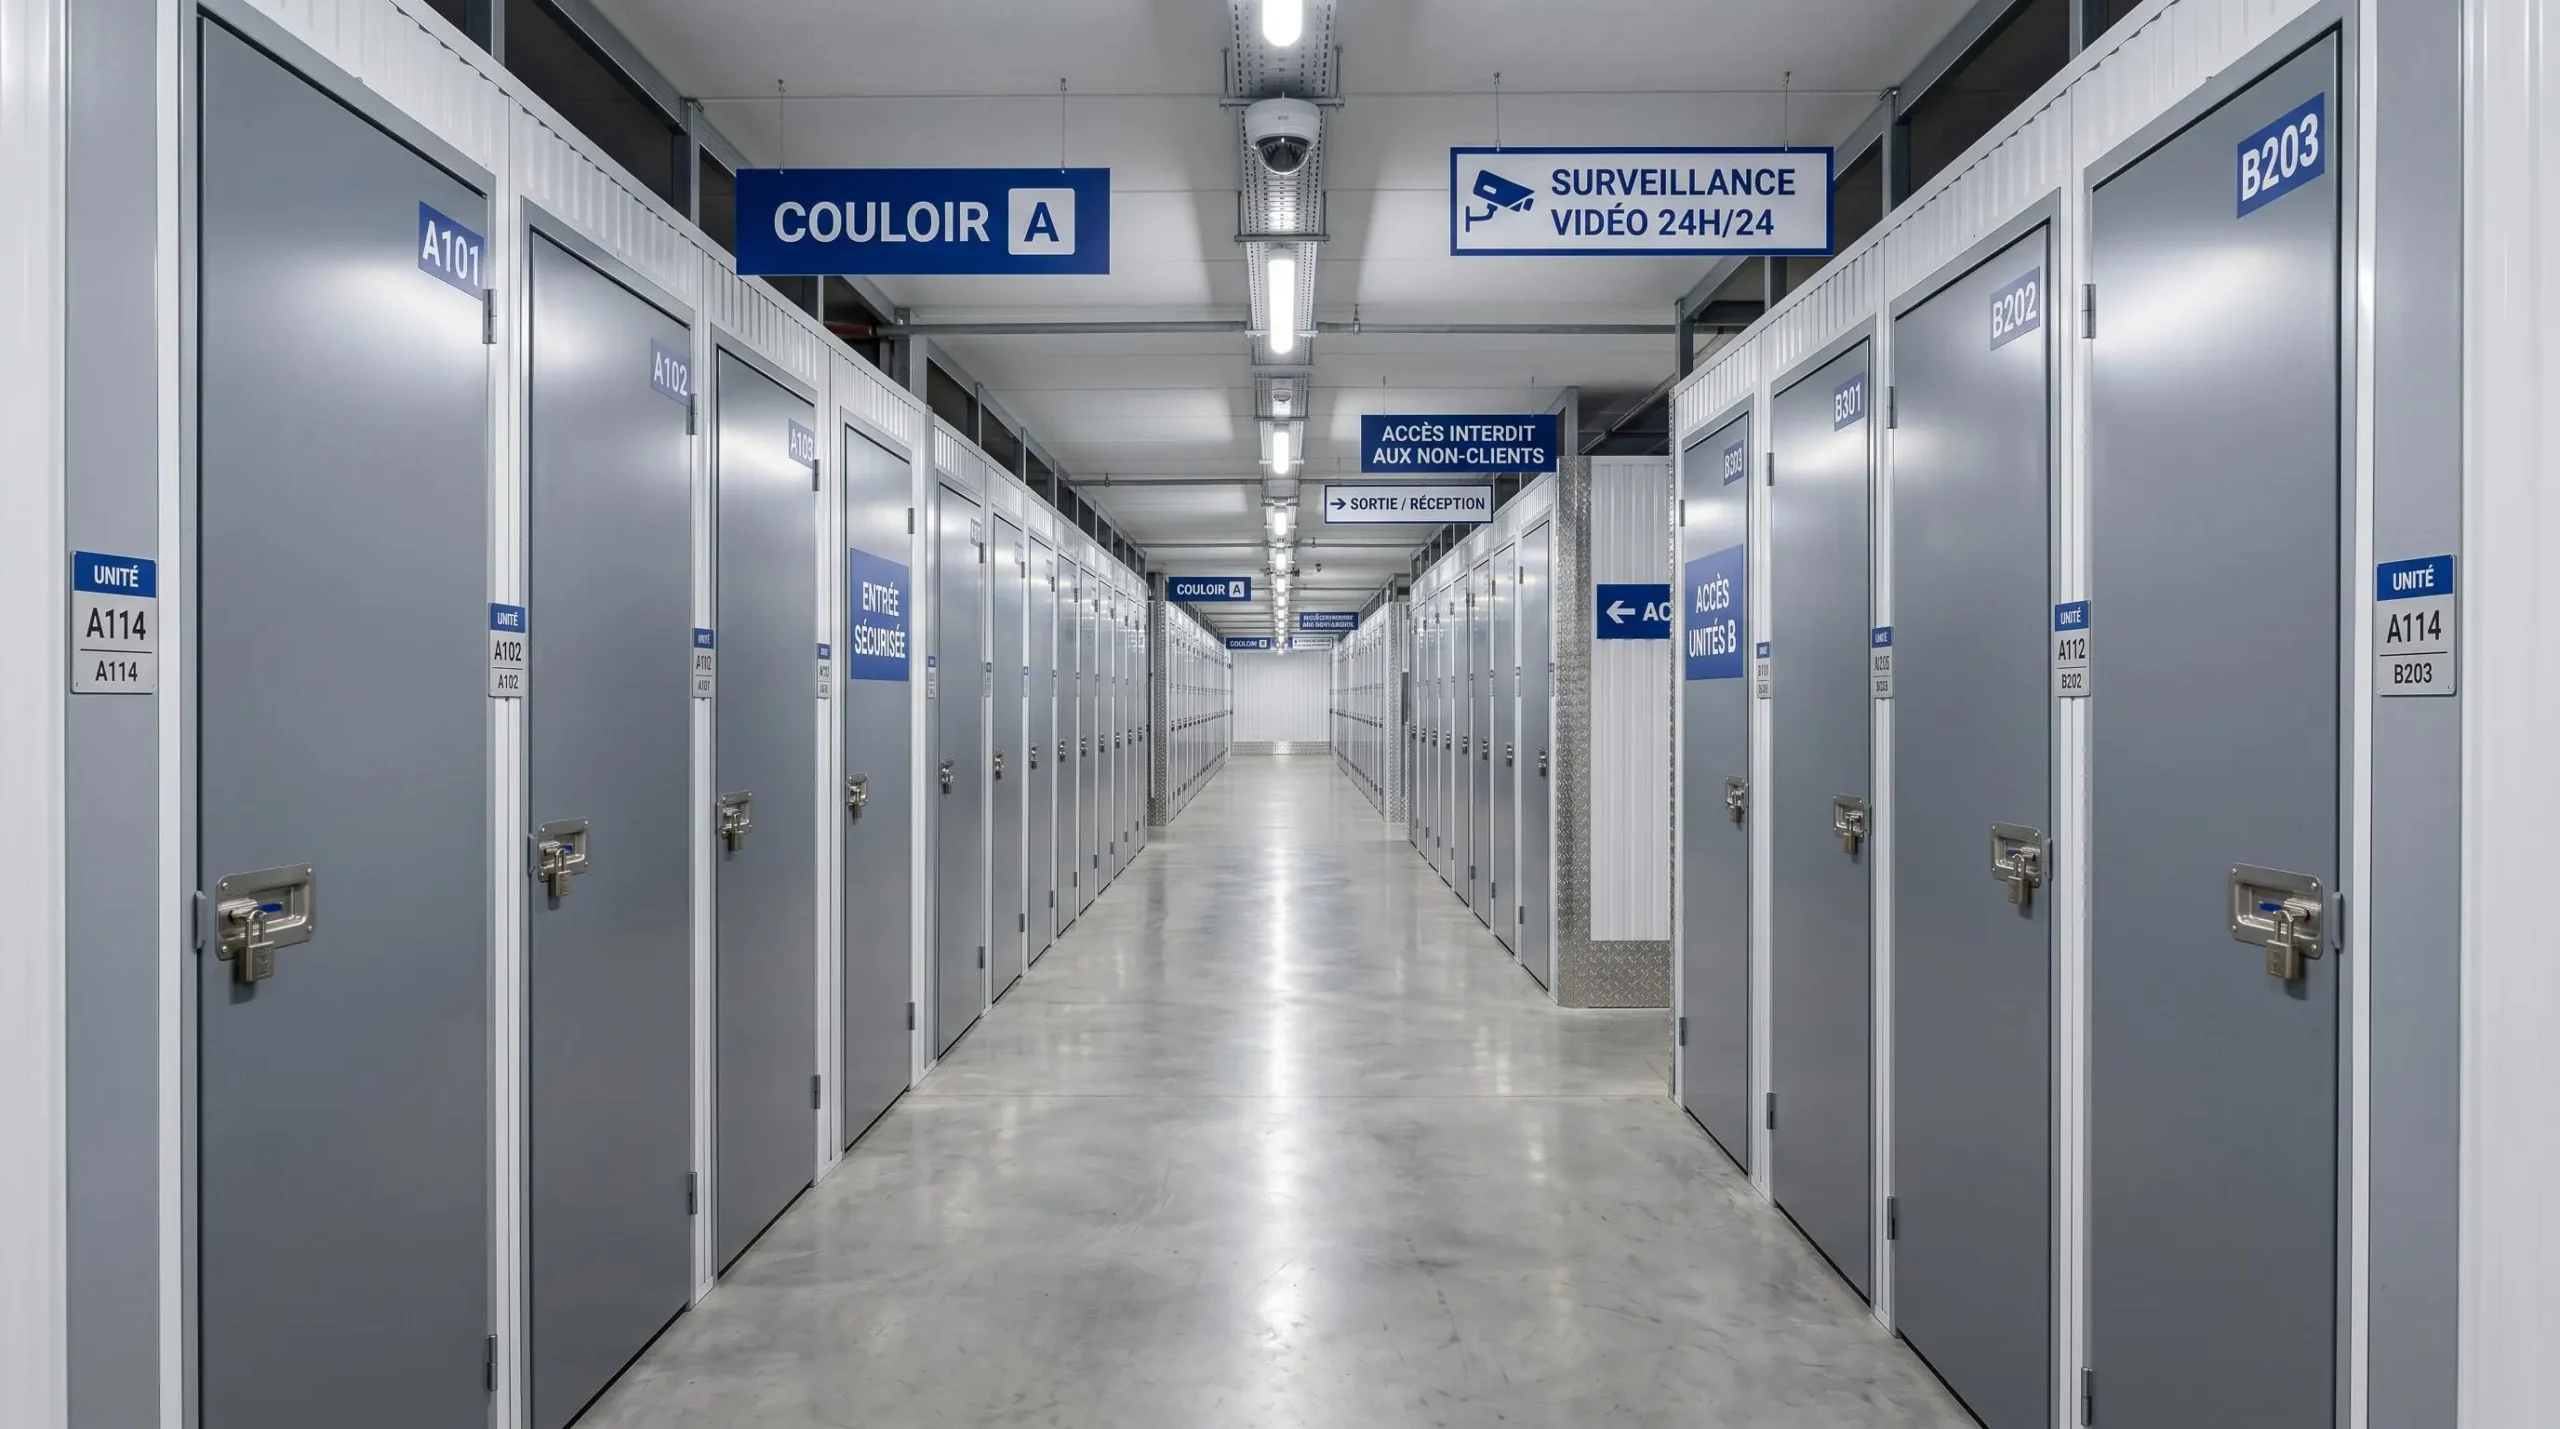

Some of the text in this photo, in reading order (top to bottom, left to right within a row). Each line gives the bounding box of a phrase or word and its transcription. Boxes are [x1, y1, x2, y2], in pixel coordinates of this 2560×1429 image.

[2242, 113, 2319, 202] B203
[1551, 168, 1796, 196] SURVEILLANCE
[774, 201, 1060, 243] COULOIR A
[1551, 202, 1775, 238] VIDÉO 24H/24
[422, 220, 479, 287] A101
[1993, 281, 2037, 340] B202
[653, 351, 688, 396] A102
[1835, 382, 1861, 422] B301
[790, 428, 814, 463] A103
[1382, 421, 1536, 442] ACCÈS INTERDIT
[1373, 447, 1545, 464] AUX NON-CLIENTS
[1350, 497, 1398, 510] SORTIE
[1410, 495, 1485, 510] RÉCEPTION
[94, 564, 139, 589] UNITÉ
[1176, 583, 1241, 595] COULOIR A
[2392, 565, 2435, 591] UNITÉ
[862, 581, 900, 617] ENTRÉE
[1695, 572, 1730, 614] ACCÈS
[86, 607, 147, 641] A114
[497, 611, 519, 627] UNITÉ
[2060, 607, 2081, 625] UNITÉ
[2386, 610, 2442, 644] A114
[494, 639, 522, 662] A102
[854, 618, 906, 659] SÉCURISÉE
[1689, 618, 1737, 658] UNITÉS B
[2058, 639, 2086, 661] A112
[95, 660, 138, 682] A114
[498, 674, 519, 690] A102
[2061, 673, 2082, 689] B202
[2394, 662, 2433, 684] B203
